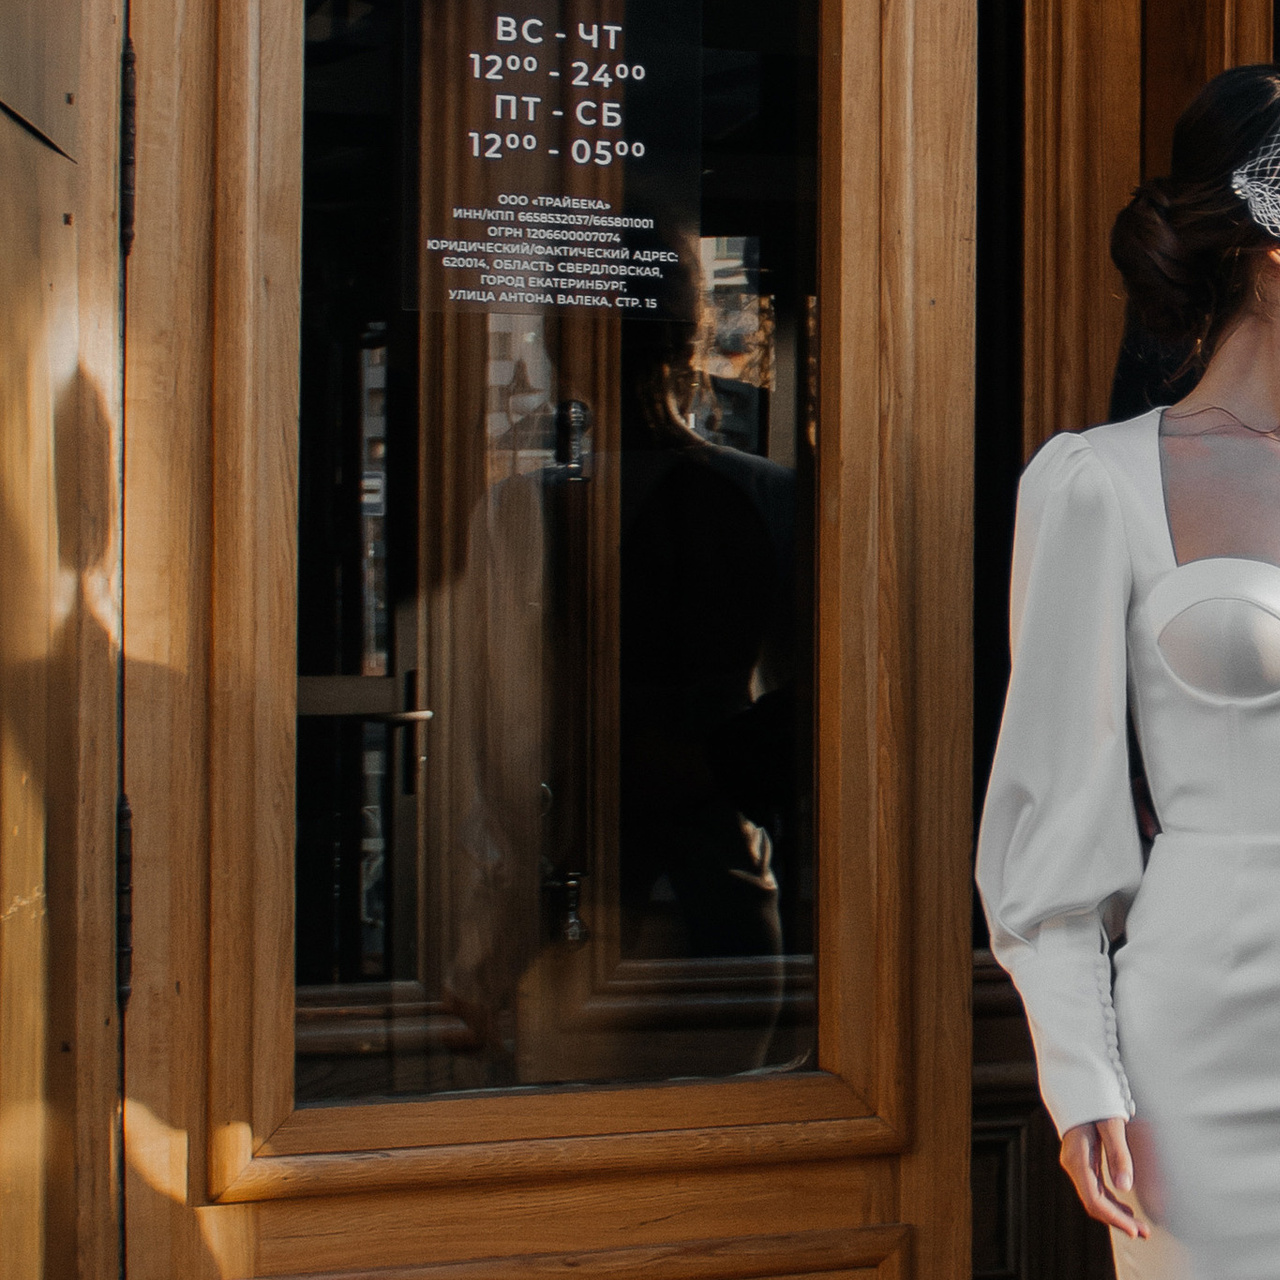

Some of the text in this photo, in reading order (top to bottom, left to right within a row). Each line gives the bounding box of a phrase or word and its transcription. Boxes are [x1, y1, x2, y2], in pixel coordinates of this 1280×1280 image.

[495, 15, 544, 44] ВС
[577, 21, 623, 50] ЧТ
[494, 93, 542, 122] ПТ
[574, 99, 622, 128] СБ
[497, 193, 529, 206] ООО
[452, 207, 515, 222] ИНН/КПП
[486, 226, 621, 243] ОГРН 1206600007074
[426, 239, 680, 264] ЮРИДИЧЕСКИЙ/ФАКТИЧЕСКИЙ АДРЕС:
[441, 256, 664, 279] 620014, ОБЛАСТЬ СВЕРДЛОВСКАЯ,
[479, 274, 629, 294] ГОРОД ЕКАТЕРИНБУРГ,
[447, 289, 658, 309] УЛИЦА АНТОНА ВАЛЕКА, СТР. 15
